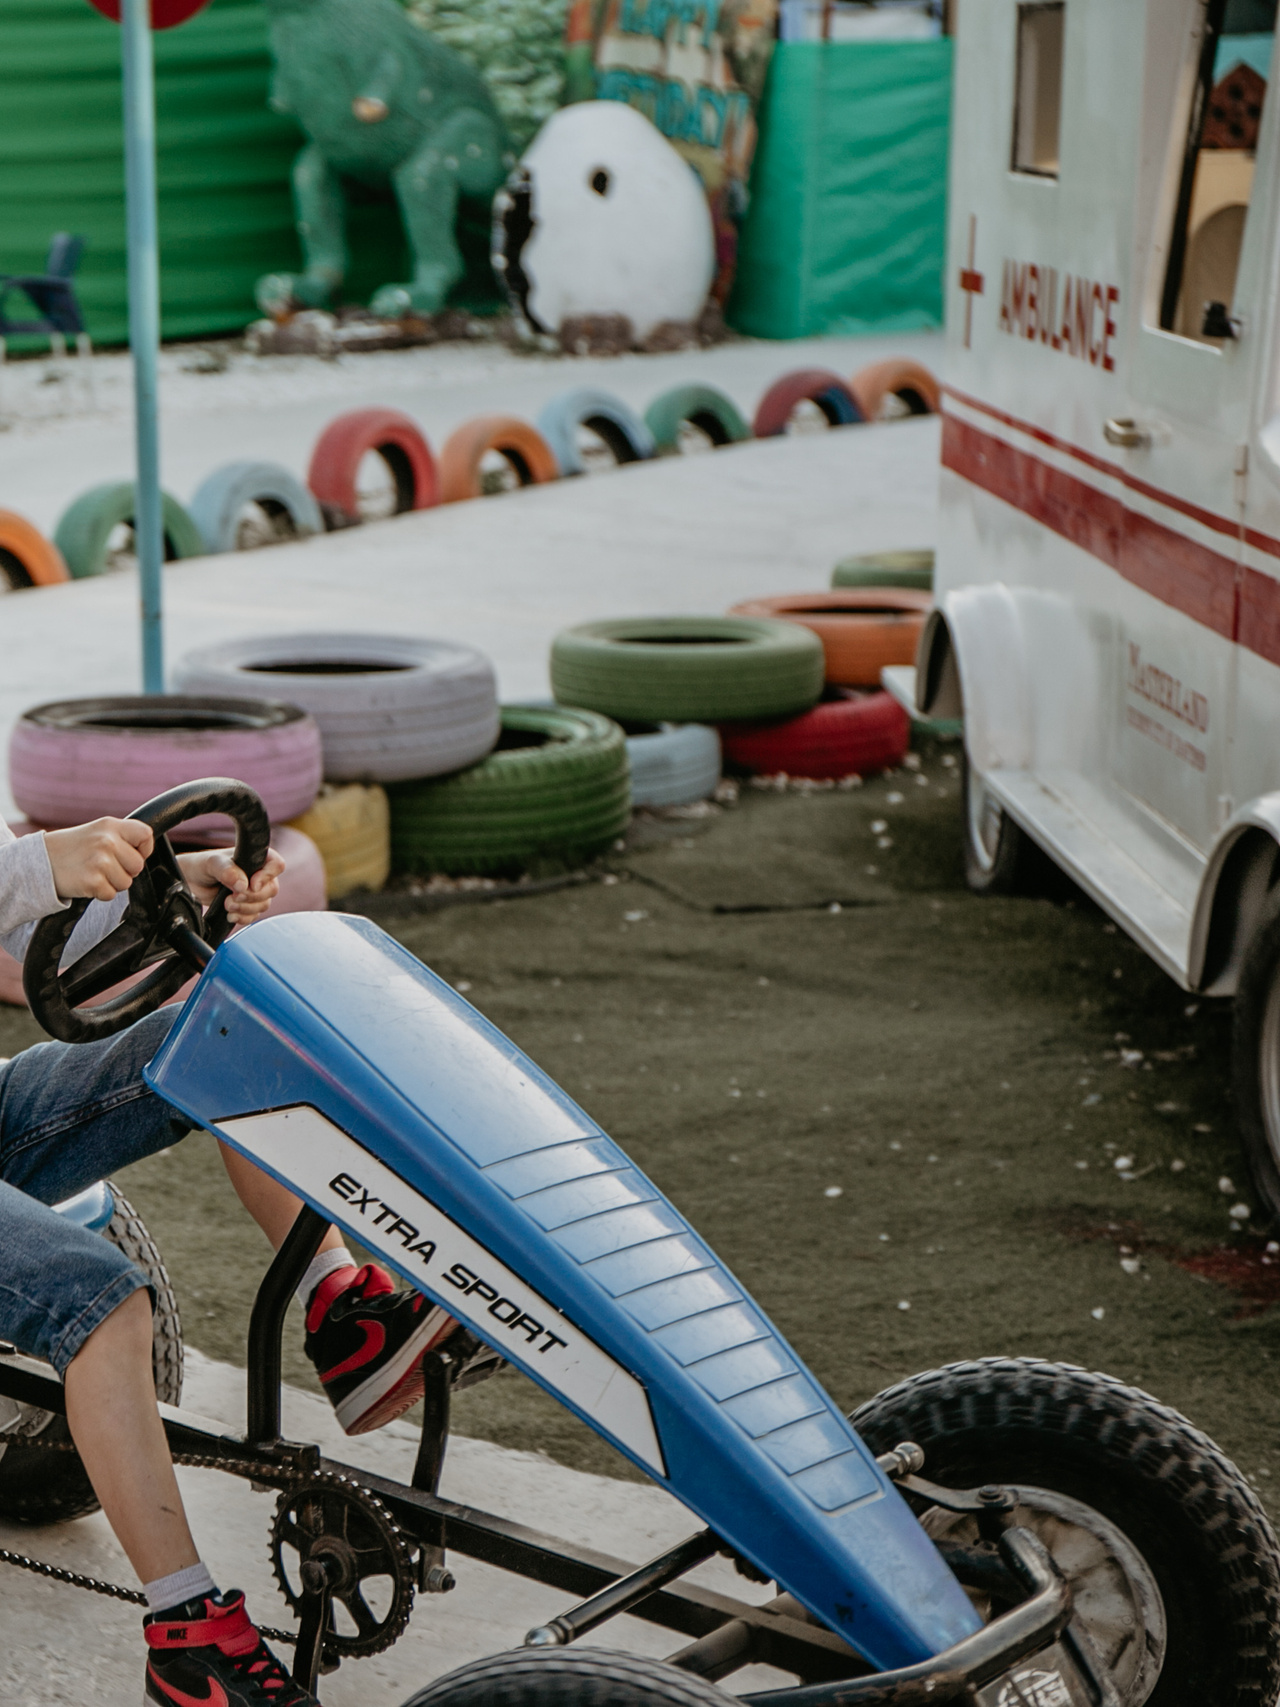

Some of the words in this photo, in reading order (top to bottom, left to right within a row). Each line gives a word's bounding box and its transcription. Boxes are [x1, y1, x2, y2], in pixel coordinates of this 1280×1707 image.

[999, 256, 1120, 374] AMBULANCE
[328, 1172, 437, 1265] EXTRA
[441, 1262, 569, 1354] SPORT
[166, 1627, 188, 1641] NIKE
